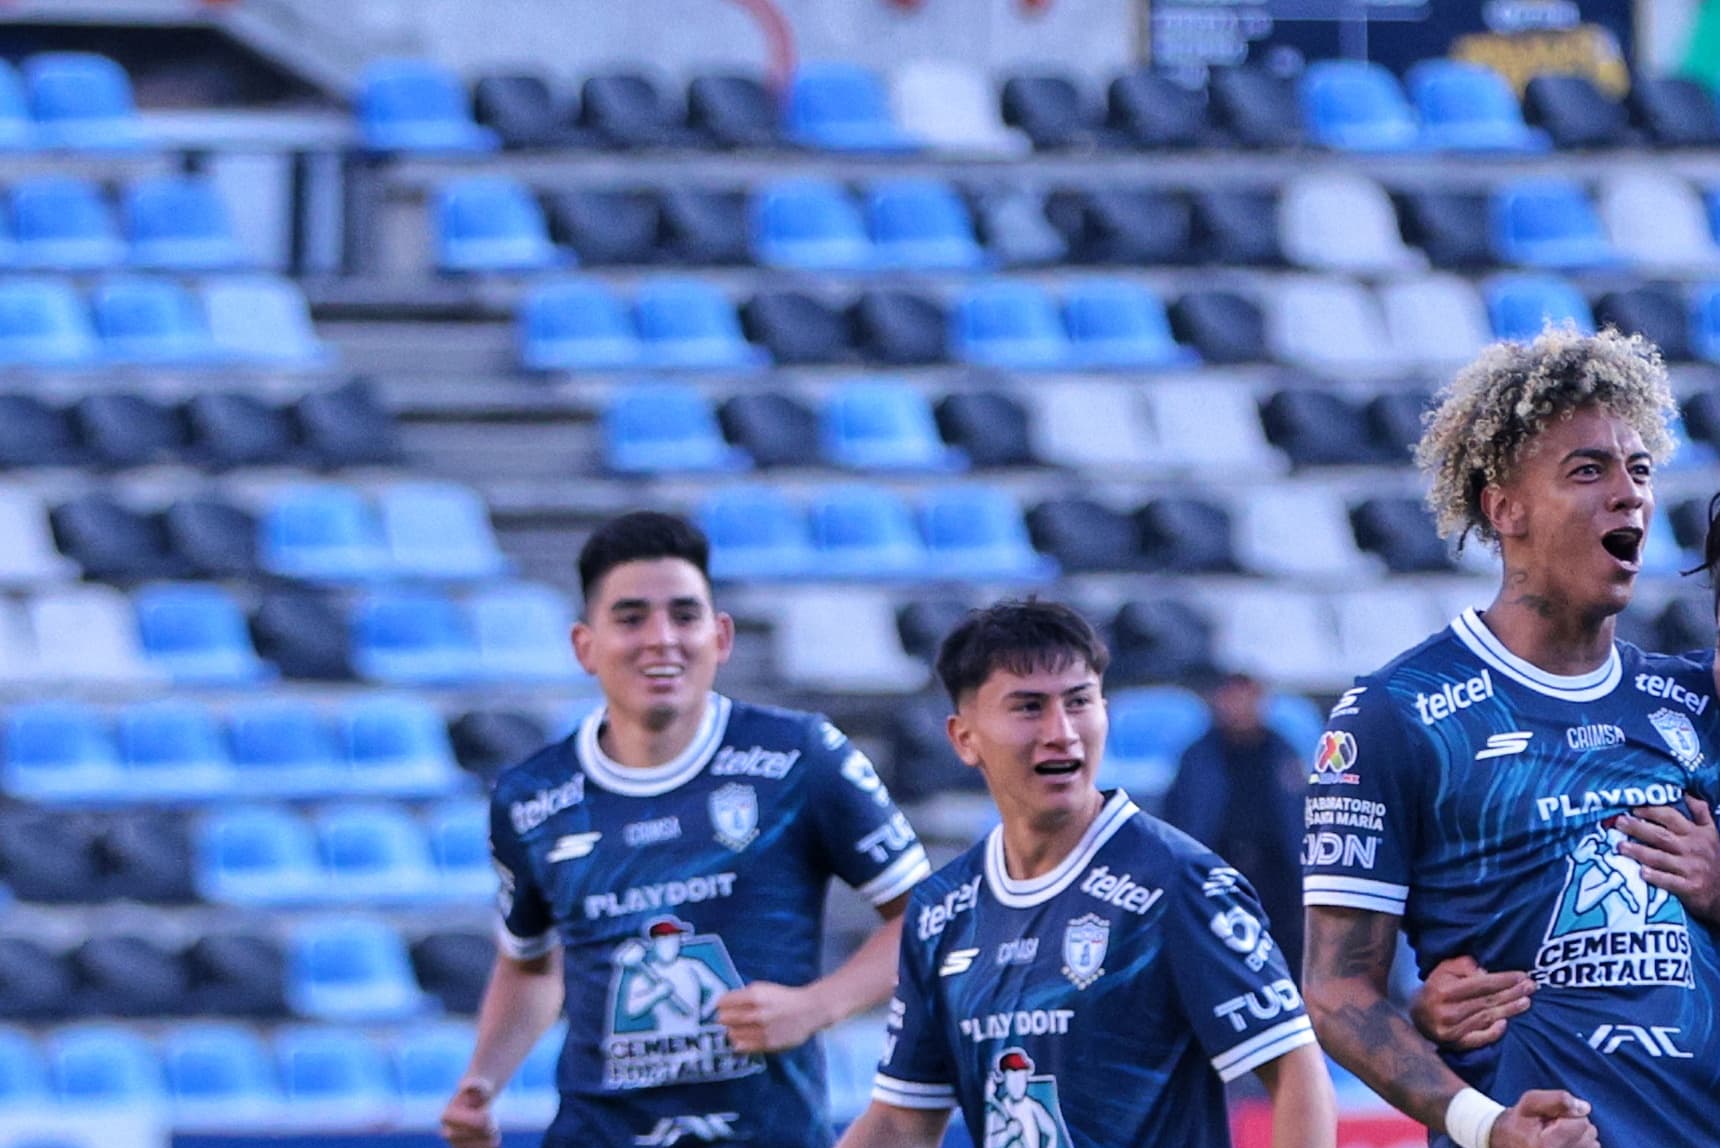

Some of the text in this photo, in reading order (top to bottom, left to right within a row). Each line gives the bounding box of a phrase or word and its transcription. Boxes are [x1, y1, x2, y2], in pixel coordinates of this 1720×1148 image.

[1416, 669, 1494, 725] telcel
[1635, 673, 1709, 716] telcel
[1566, 724, 1626, 750] CRIMSA
[711, 746, 801, 780] telcel
[510, 773, 585, 834] telcel
[583, 872, 737, 920] PLAYDOIT
[1080, 866, 1163, 914] telcel
[1531, 958, 1693, 985] FORTALEZA
[1538, 930, 1688, 968] CEMENTOS
[1213, 979, 1300, 1032] TUD
